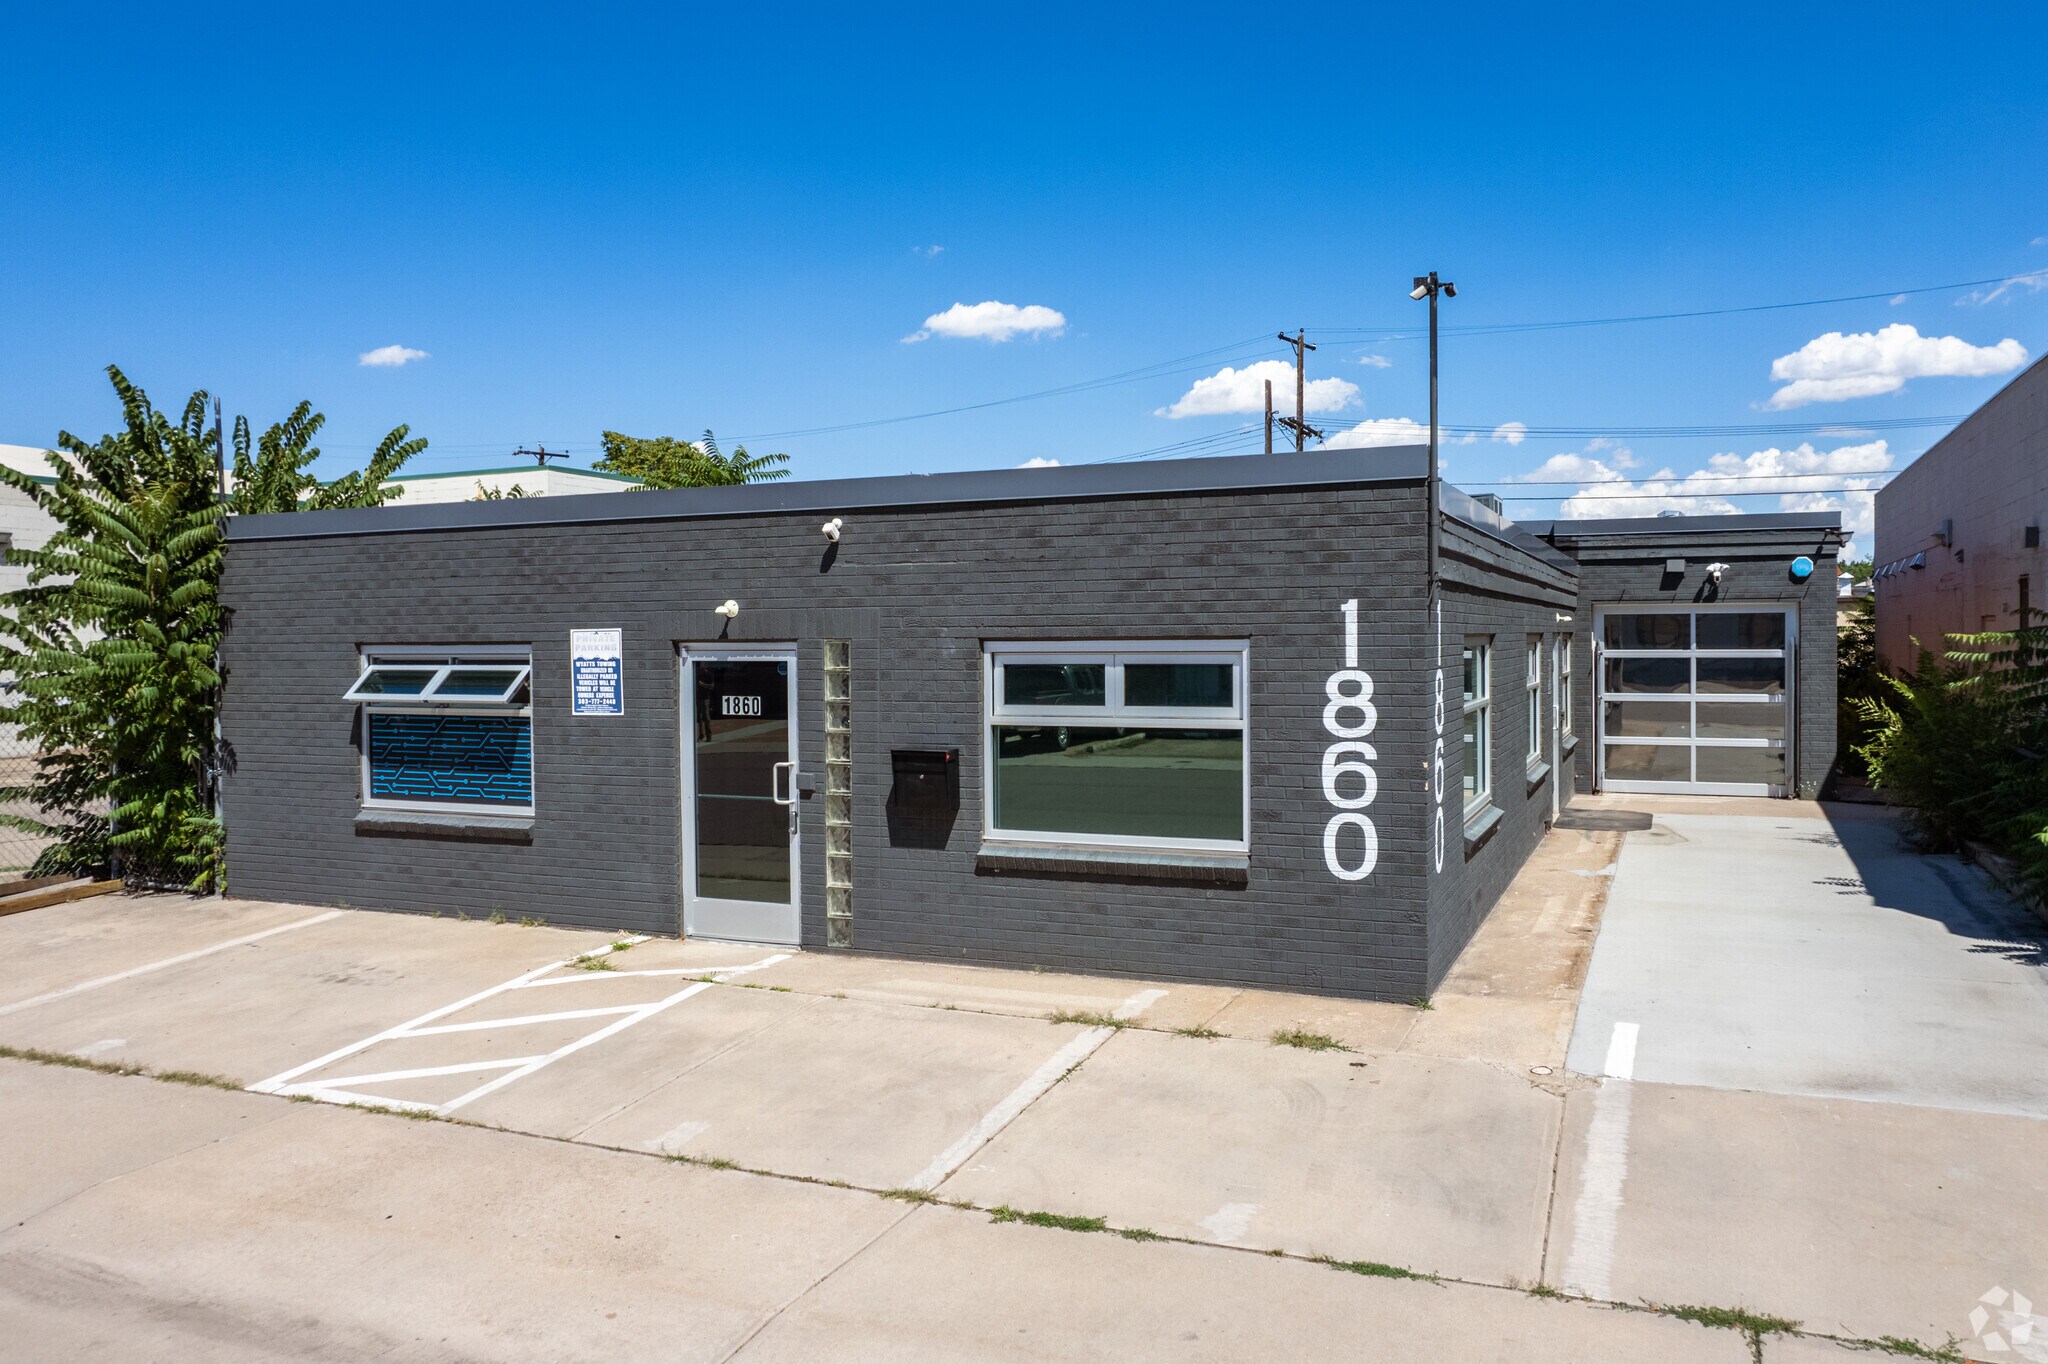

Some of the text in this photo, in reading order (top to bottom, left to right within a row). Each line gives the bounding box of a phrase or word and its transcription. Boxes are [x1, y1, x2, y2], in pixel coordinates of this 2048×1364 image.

[724, 696, 760, 715] 1860
[1321, 598, 1378, 881] 1860
[1434, 599, 1444, 874] 1860
